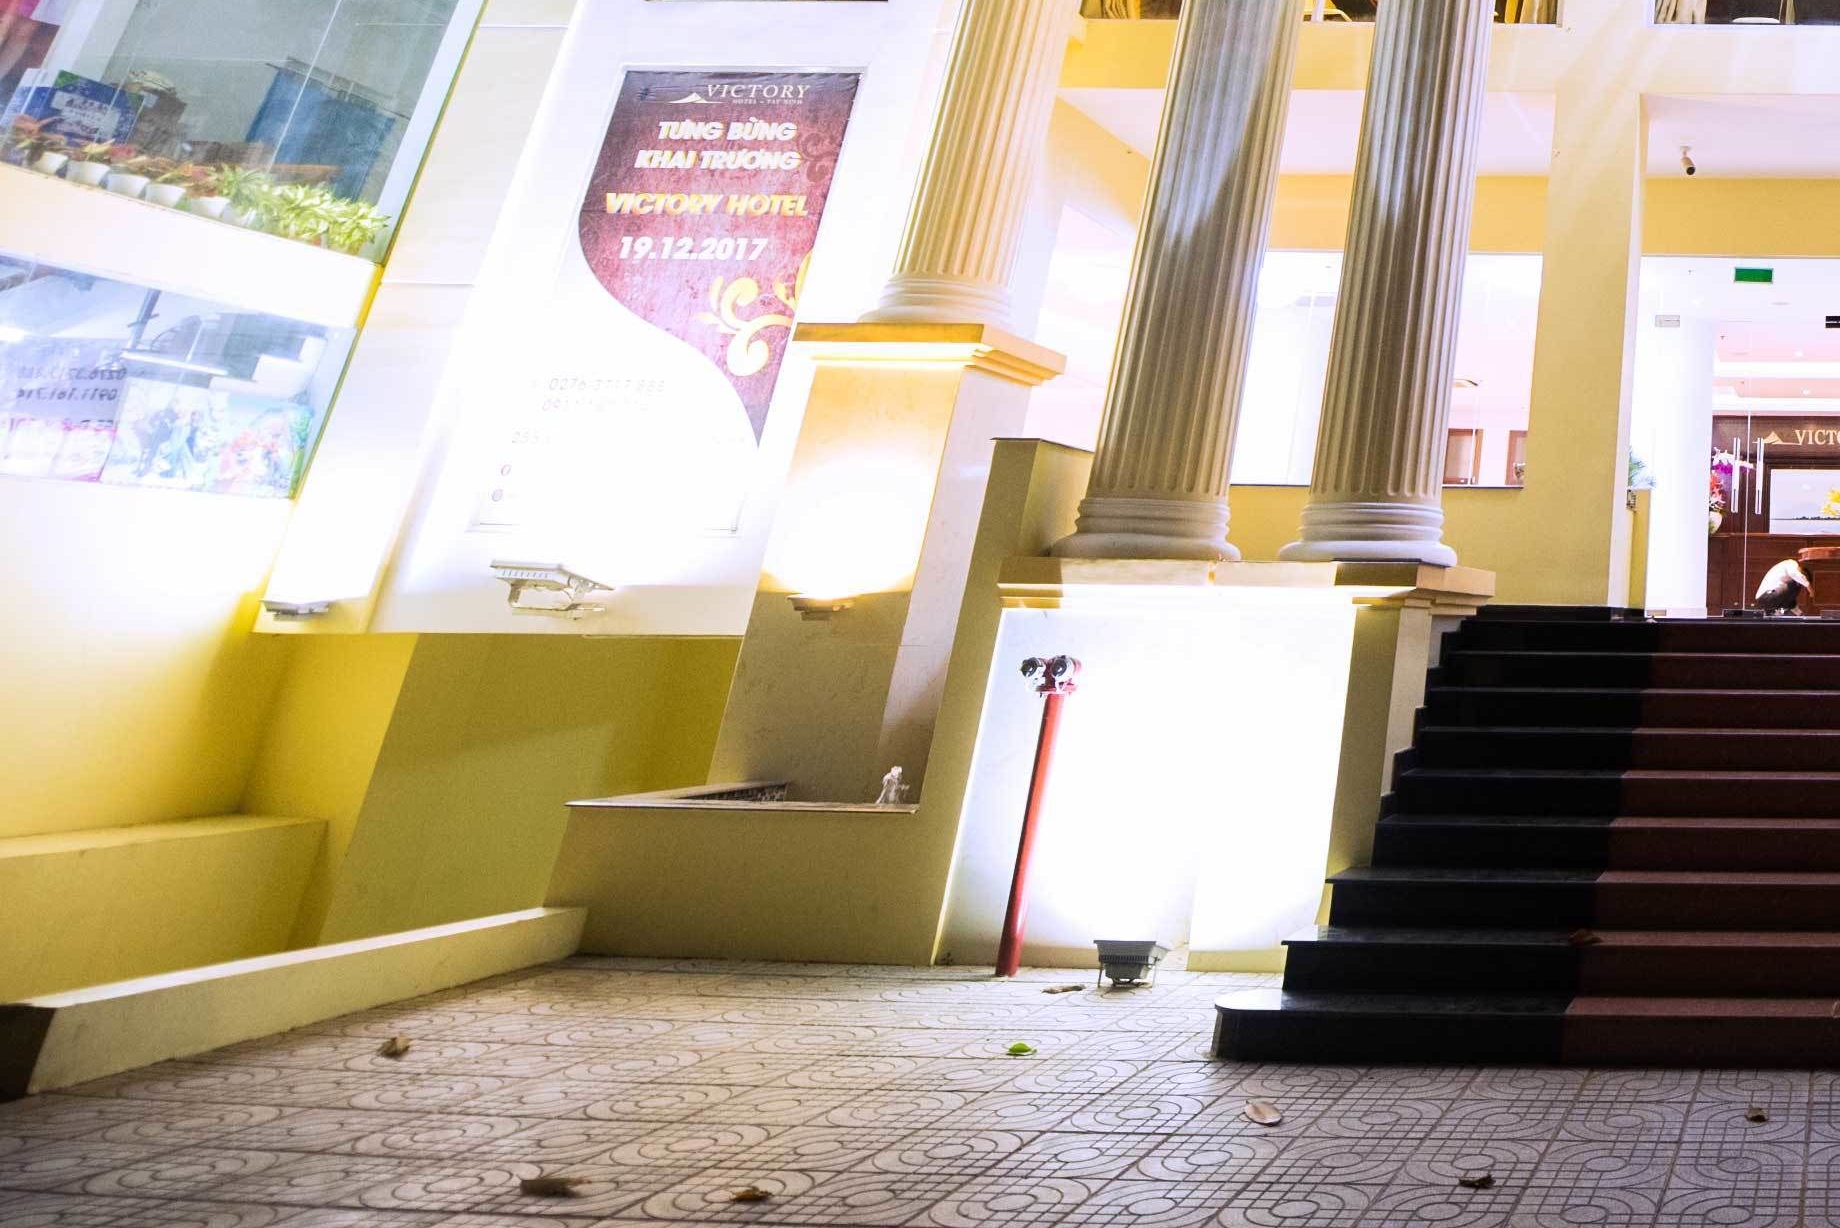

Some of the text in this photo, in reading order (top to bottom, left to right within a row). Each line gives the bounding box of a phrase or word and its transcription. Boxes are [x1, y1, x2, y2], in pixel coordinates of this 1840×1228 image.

[706, 83, 811, 99] VICTORY
[634, 148, 699, 169] KHAI
[604, 192, 810, 217] VICTORY HOTEL
[618, 236, 769, 260] 19.12.2017
